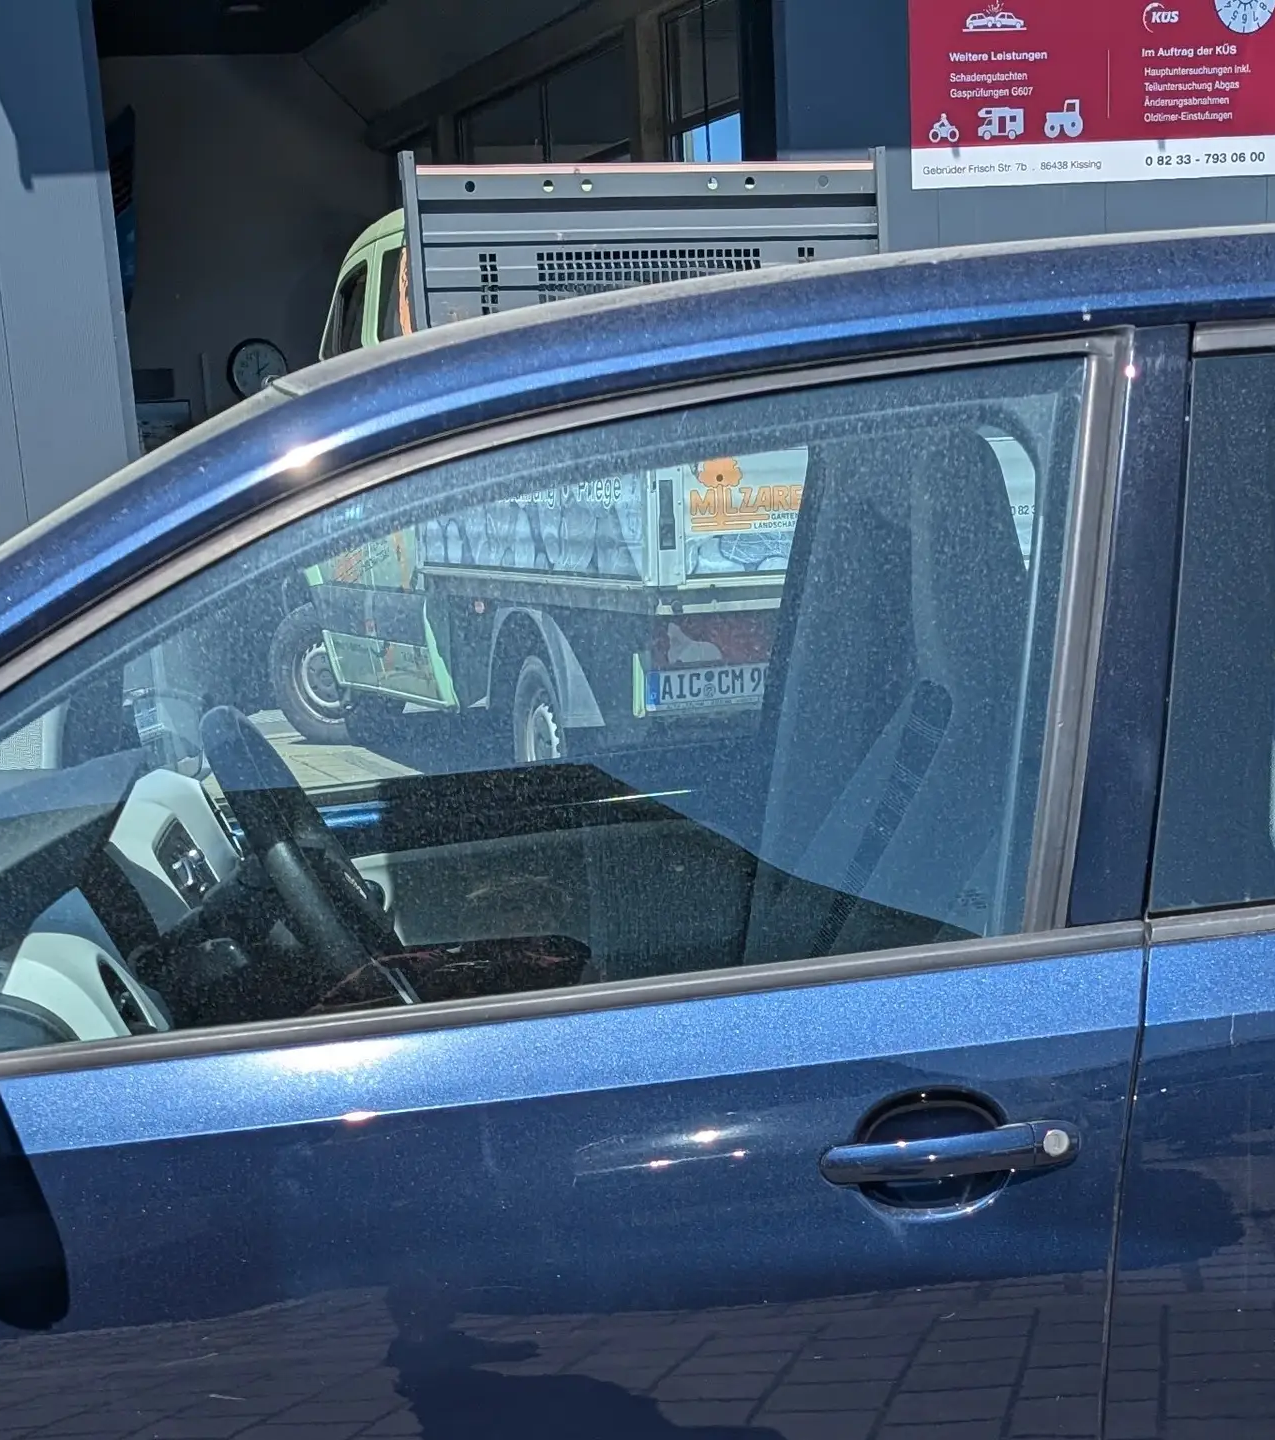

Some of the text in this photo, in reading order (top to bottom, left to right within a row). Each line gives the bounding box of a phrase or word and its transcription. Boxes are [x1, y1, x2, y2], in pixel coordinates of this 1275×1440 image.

[1142, 43, 1237, 57] Im Auftrag der KÜS
[949, 51, 1047, 62] Weitere Leistungen
[949, 71, 1027, 83] Schadengutachten
[1144, 66, 1232, 77] Hauptuntersuchungen
[1144, 80, 1239, 92] Teiluntersuchung Abgas
[950, 86, 1033, 99] Gasprüfungen G607
[1144, 96, 1229, 108] Änderungsabnahmen
[1145, 156, 1153, 166] 0
[1157, 155, 1172, 165] 82
[1176, 154, 1191, 165] 33
[1205, 153, 1226, 164] 793
[1231, 152, 1246, 162] 06
[1250, 151, 1265, 162] 00
[922, 165, 966, 176] Gebrüder
[968, 163, 995, 174] Frisch
[998, 162, 1013, 172] Str.
[1015, 162, 1027, 172] 7b
[1040, 161, 1068, 171] 86438
[1070, 159, 1102, 170] Kissing
[661, 673, 701, 700] AIC
[718, 668, 744, 695] CM
